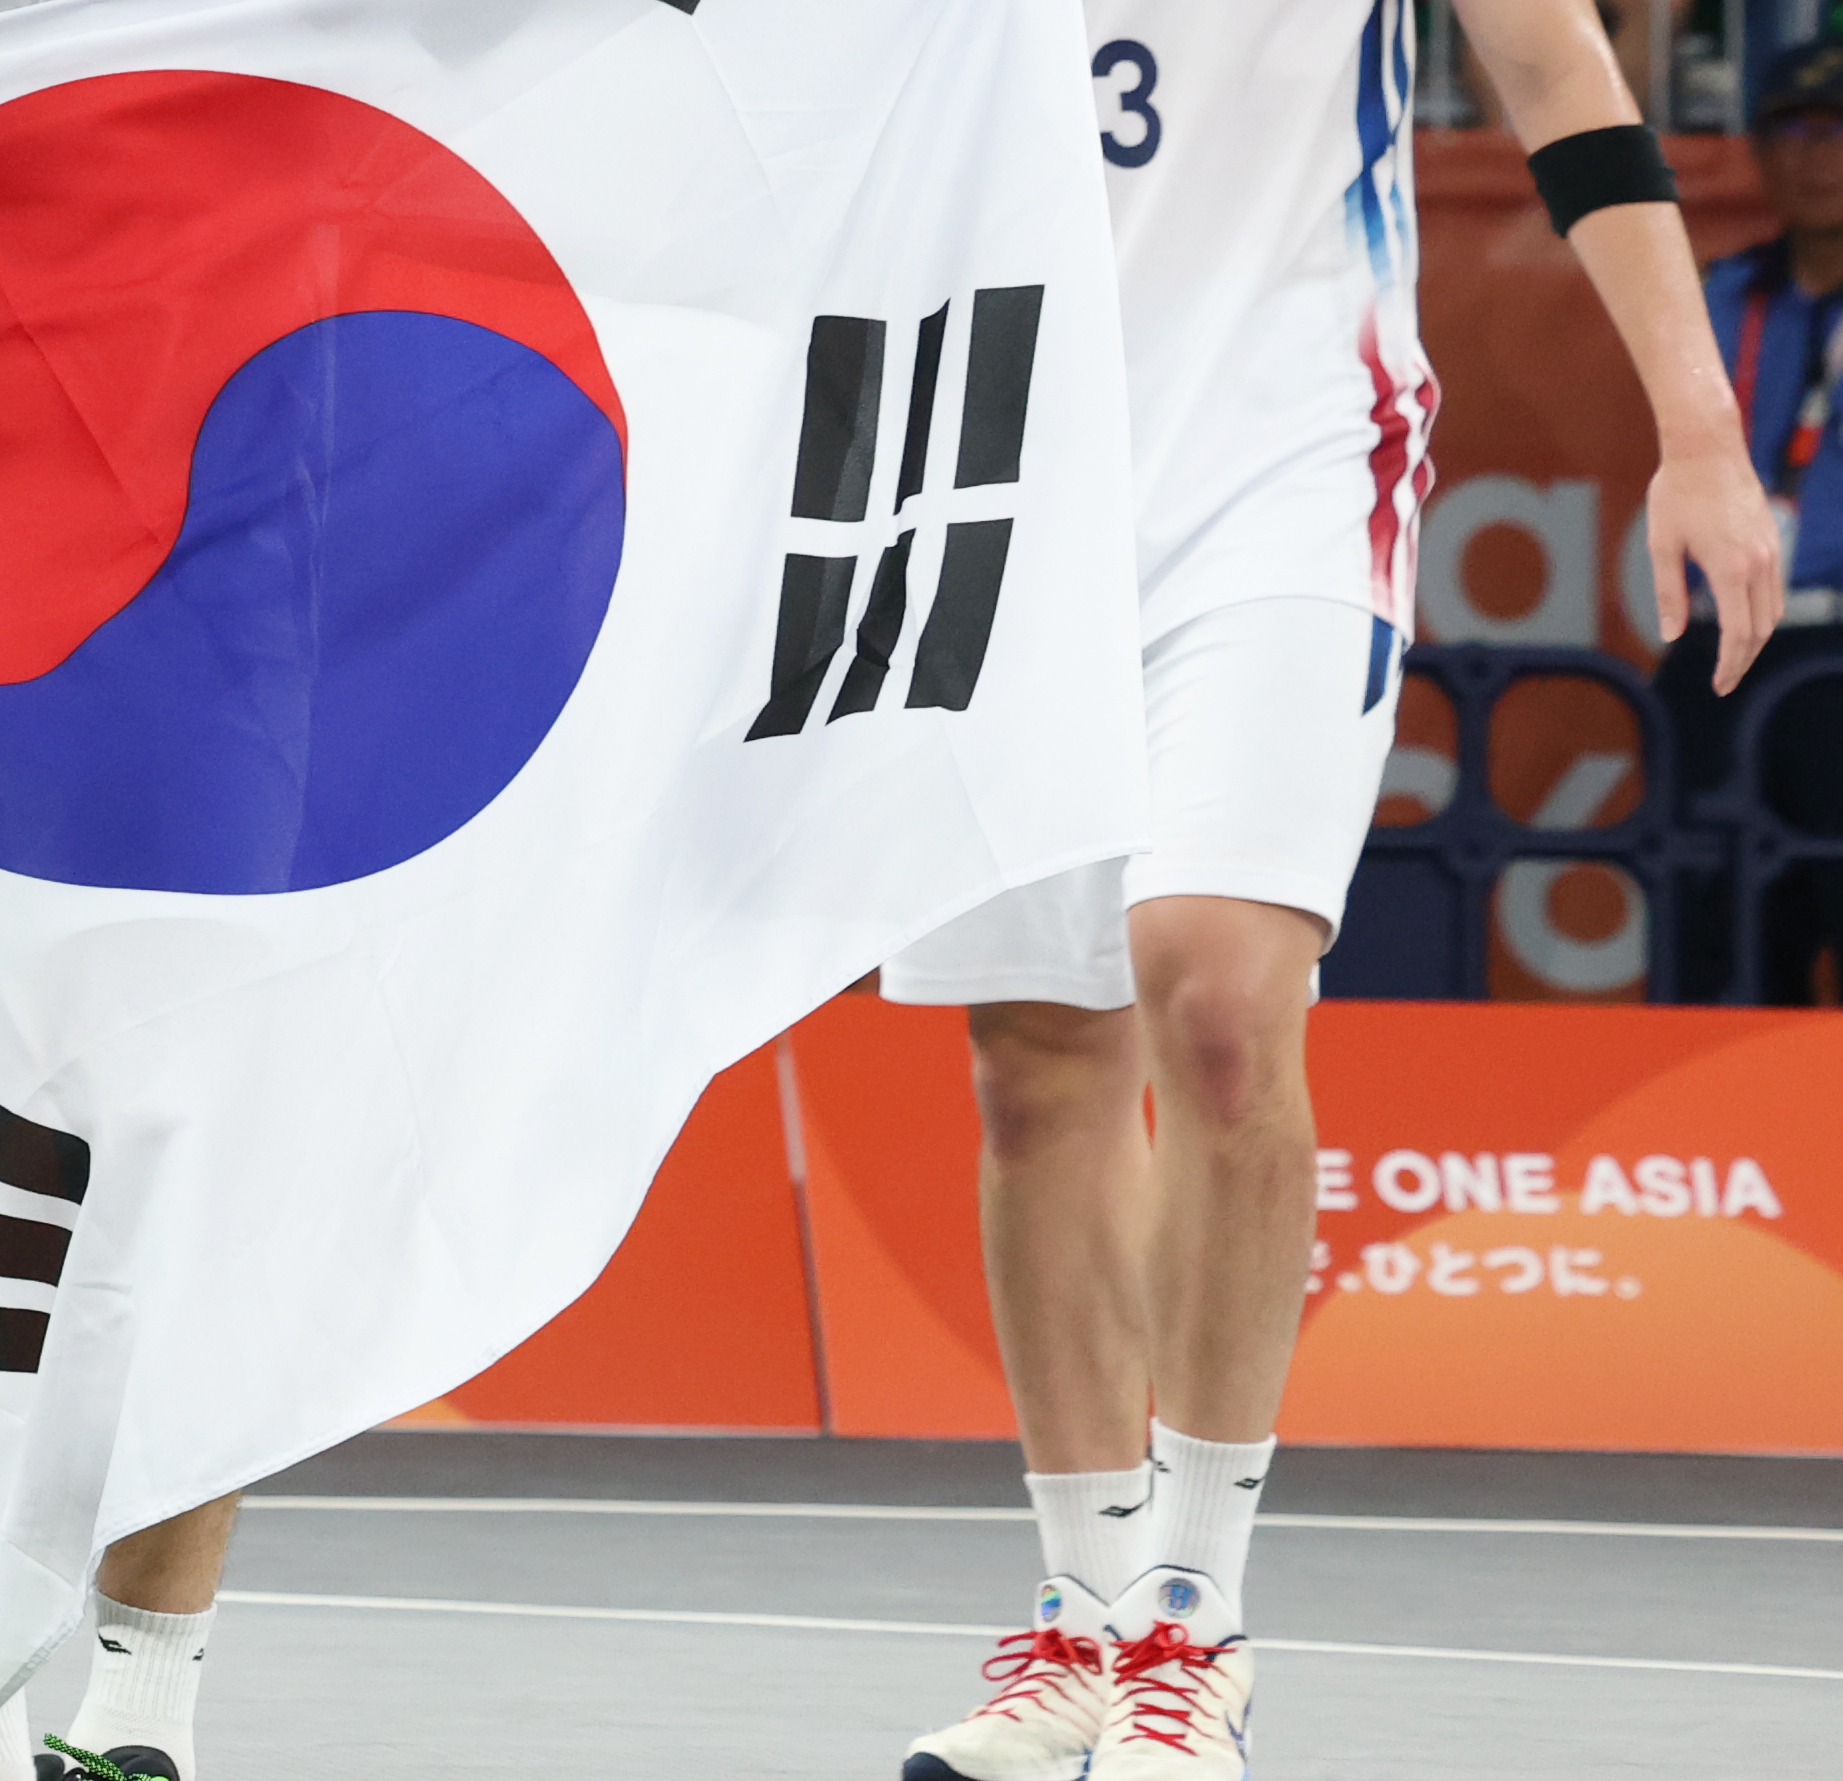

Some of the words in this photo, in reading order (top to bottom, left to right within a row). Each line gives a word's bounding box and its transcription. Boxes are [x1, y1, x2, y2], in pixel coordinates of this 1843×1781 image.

[1091, 38, 1163, 170] 3
[1371, 1148, 1563, 1215] ONE
[1578, 1152, 1785, 1220] ASIA
